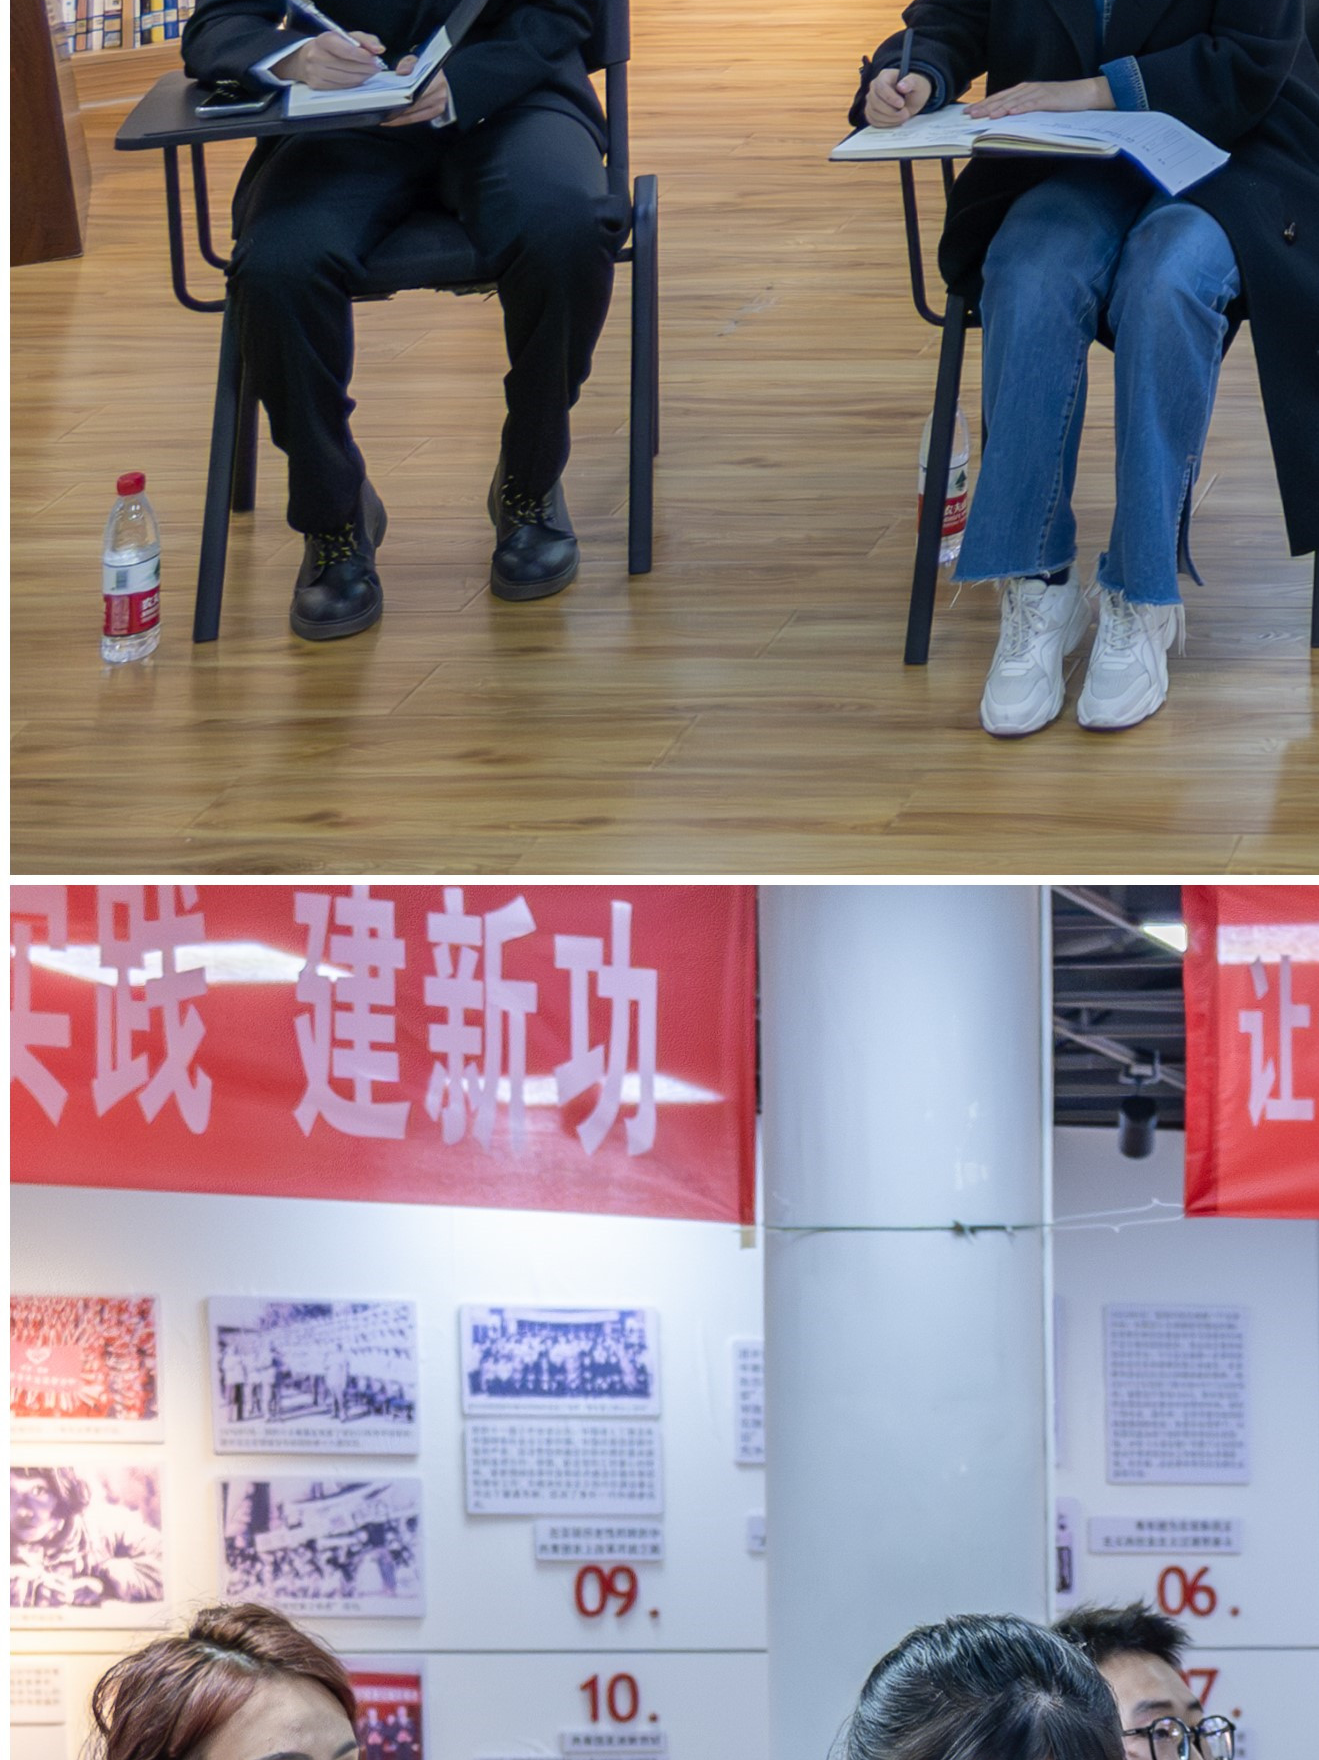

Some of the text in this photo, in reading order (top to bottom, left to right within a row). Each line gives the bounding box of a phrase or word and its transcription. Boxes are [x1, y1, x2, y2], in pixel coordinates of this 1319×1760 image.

[293, 884, 661, 1158] 建新功
[574, 1565, 660, 1619] 09.
[1157, 1566, 1240, 1617] 06.
[580, 1672, 659, 1724] 10.
